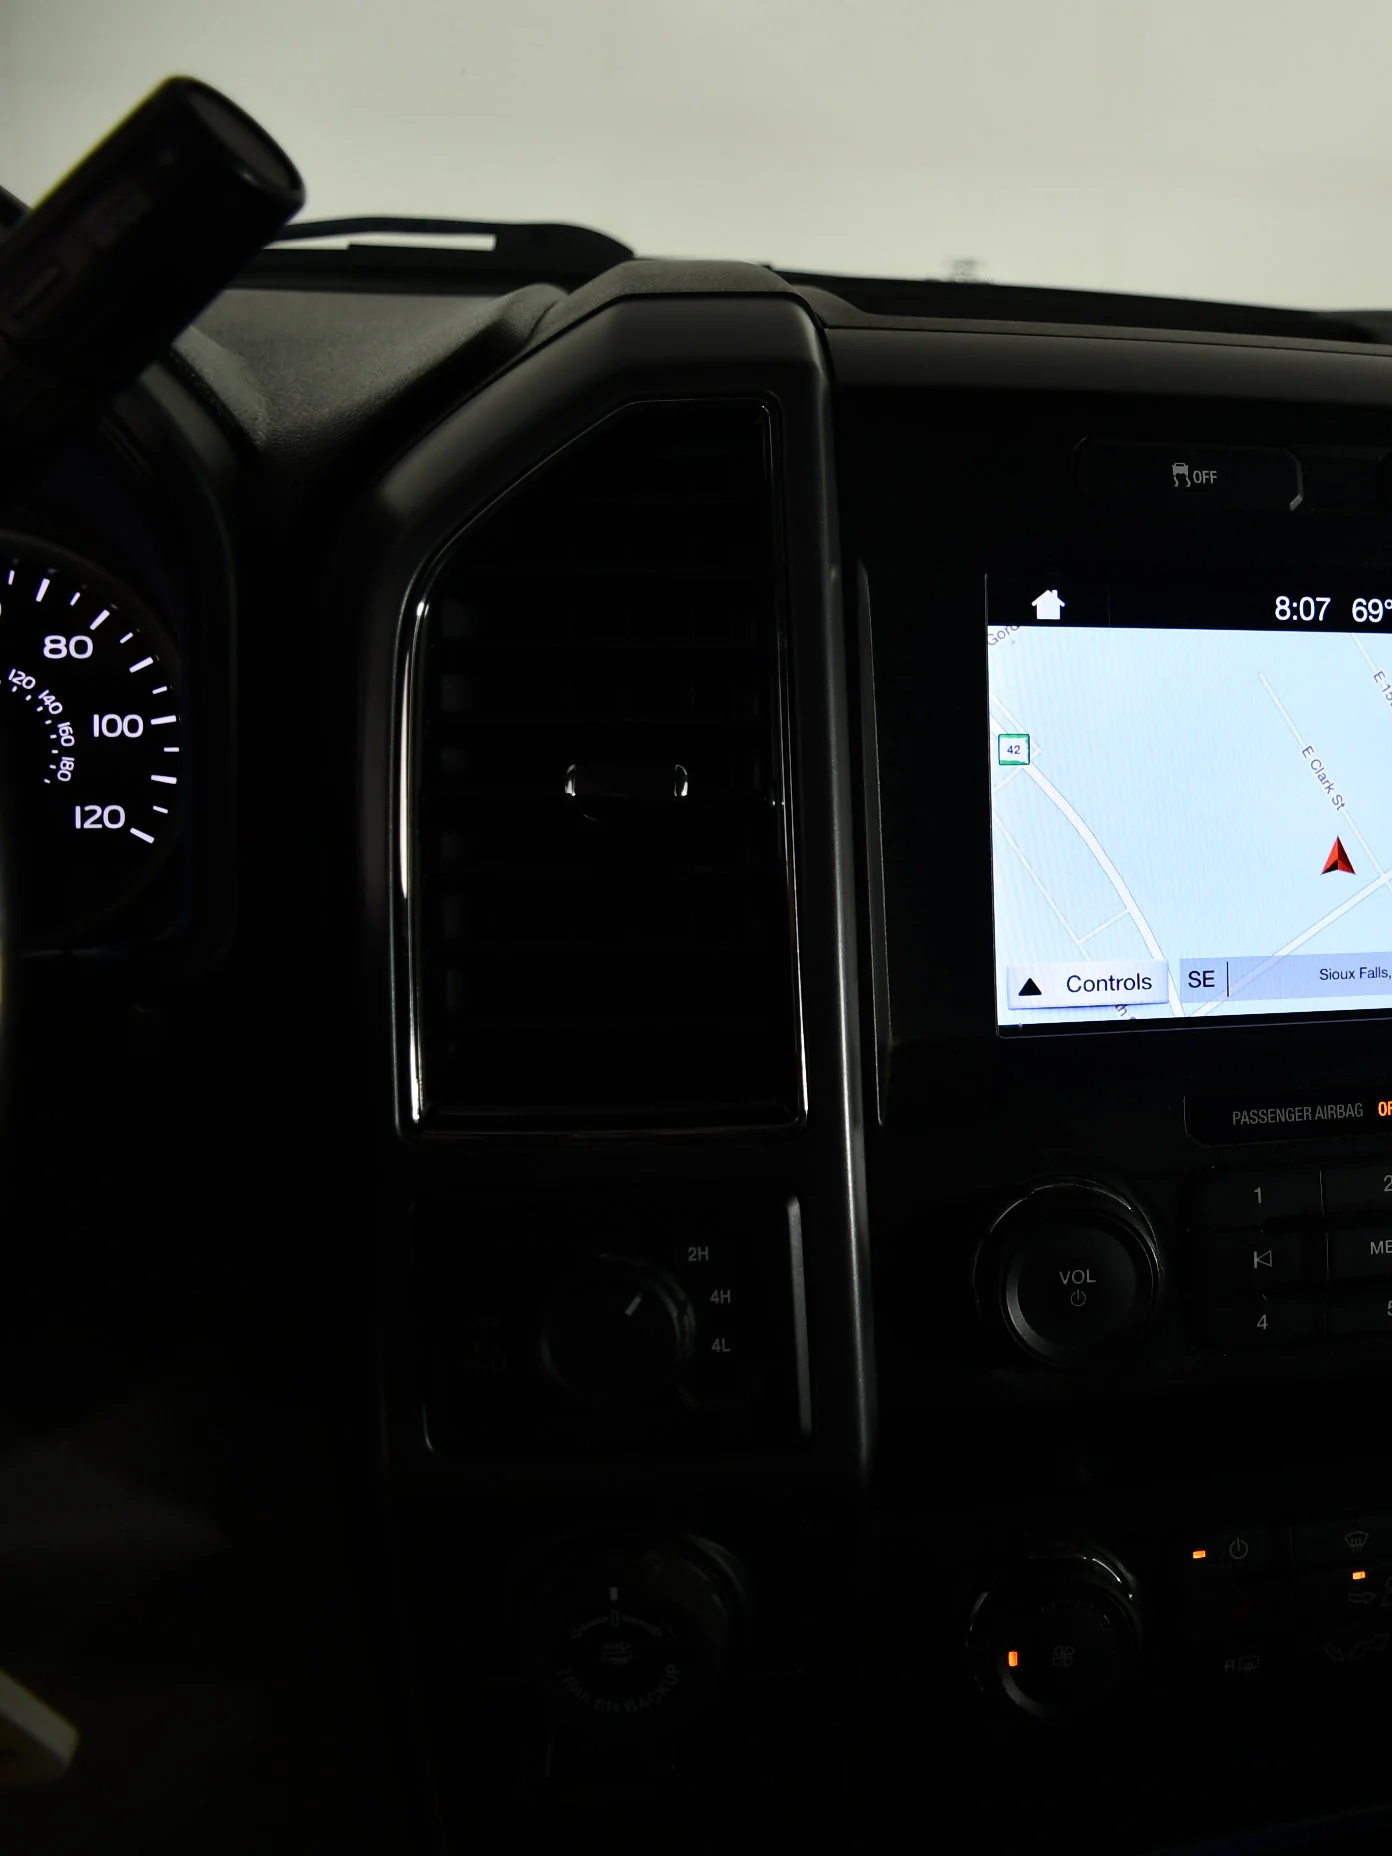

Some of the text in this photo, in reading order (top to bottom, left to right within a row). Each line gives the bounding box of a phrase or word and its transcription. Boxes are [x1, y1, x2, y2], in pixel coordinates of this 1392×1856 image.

[1192, 469, 1218, 485] OFF
[1274, 595, 1332, 622] 8:07
[42, 634, 94, 660] 80
[8, 668, 36, 690] 120
[1373, 670, 1386, 683] E
[38, 689, 63, 715] 140
[57, 721, 75, 747] 160
[92, 713, 145, 739] 100
[1006, 744, 1021, 755] 42
[57, 756, 75, 782] 180
[1302, 745, 1346, 811] E Clark St
[74, 804, 126, 830] 120
[1066, 973, 1153, 993] Controls
[1187, 970, 1215, 988] SE
[1319, 967, 1356, 981] Sioux
[1359, 965, 1392, 980] Falls,
[1231, 1105, 1313, 1126] PASSENGER
[1315, 1102, 1364, 1121] AIRBAG
[1253, 1187, 1264, 1204] 1
[687, 1245, 709, 1262] 2H
[1058, 1268, 1096, 1287] VOL
[709, 1288, 732, 1304] 4H
[1256, 1313, 1270, 1331] 4
[711, 1336, 732, 1353] 4L
[557, 1663, 682, 1715] TRAILER BACKUP
